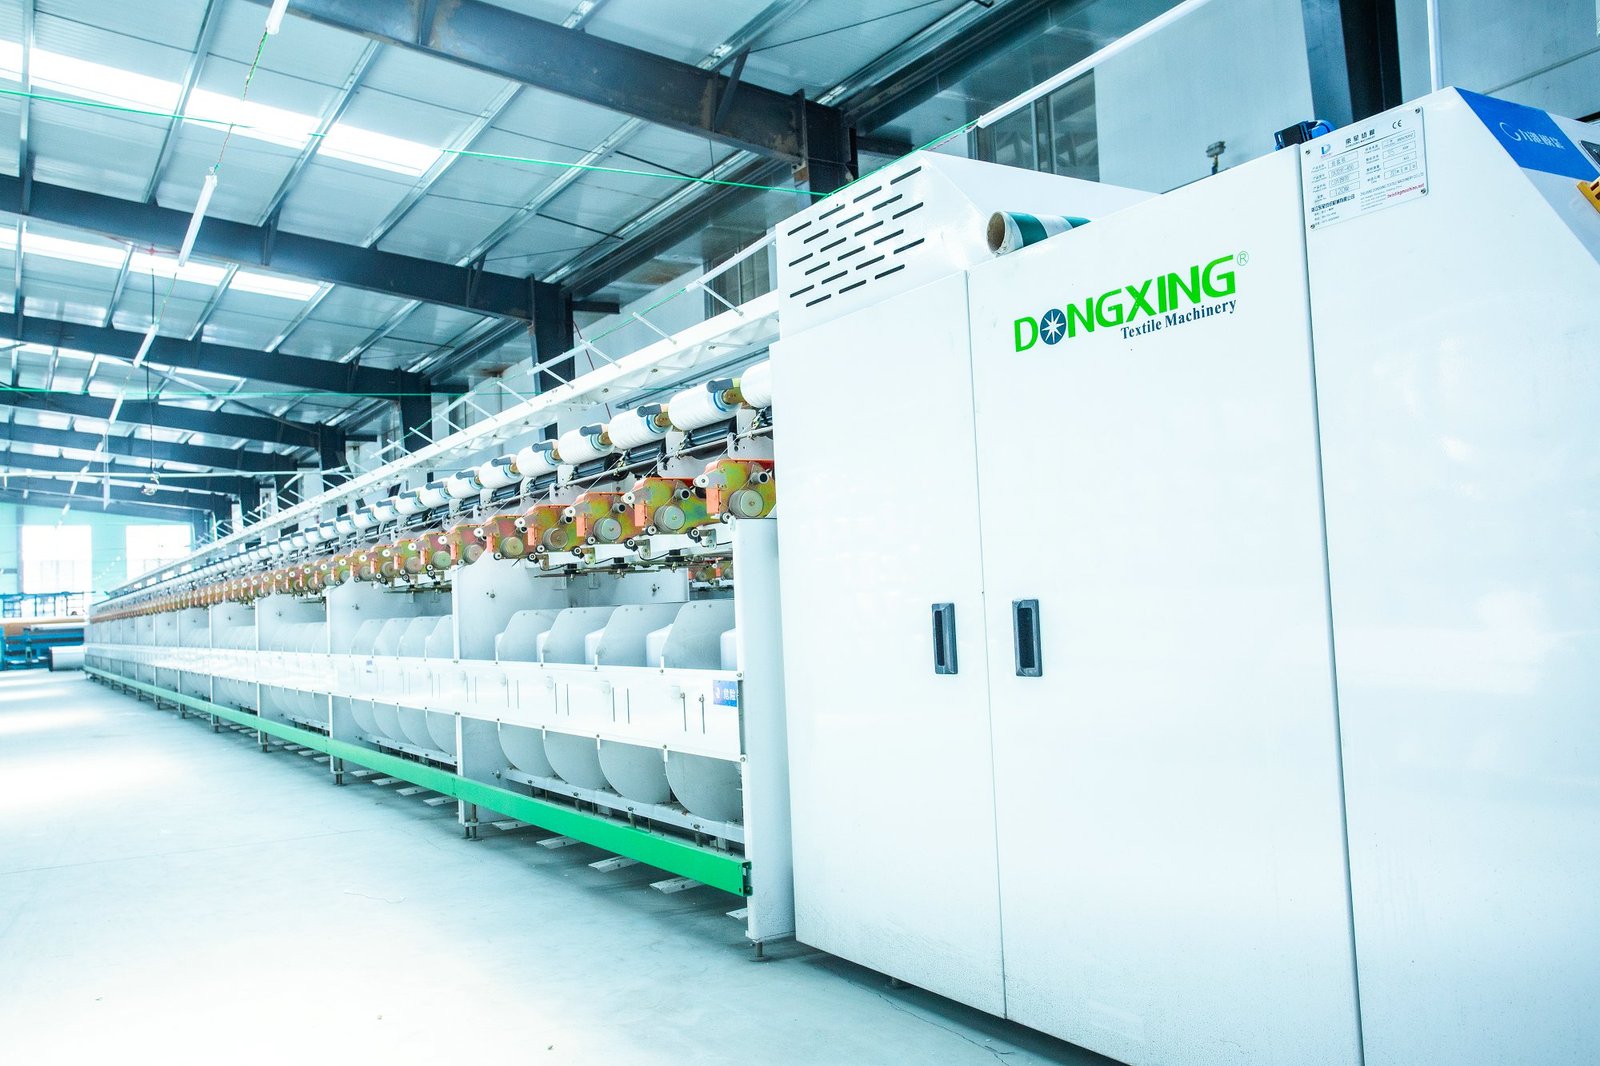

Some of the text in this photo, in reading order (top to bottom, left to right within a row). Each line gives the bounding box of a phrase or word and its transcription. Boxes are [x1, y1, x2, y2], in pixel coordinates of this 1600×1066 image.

[1014, 254, 1236, 352] DONGXING
[1120, 299, 1237, 340] Textile Machinery
